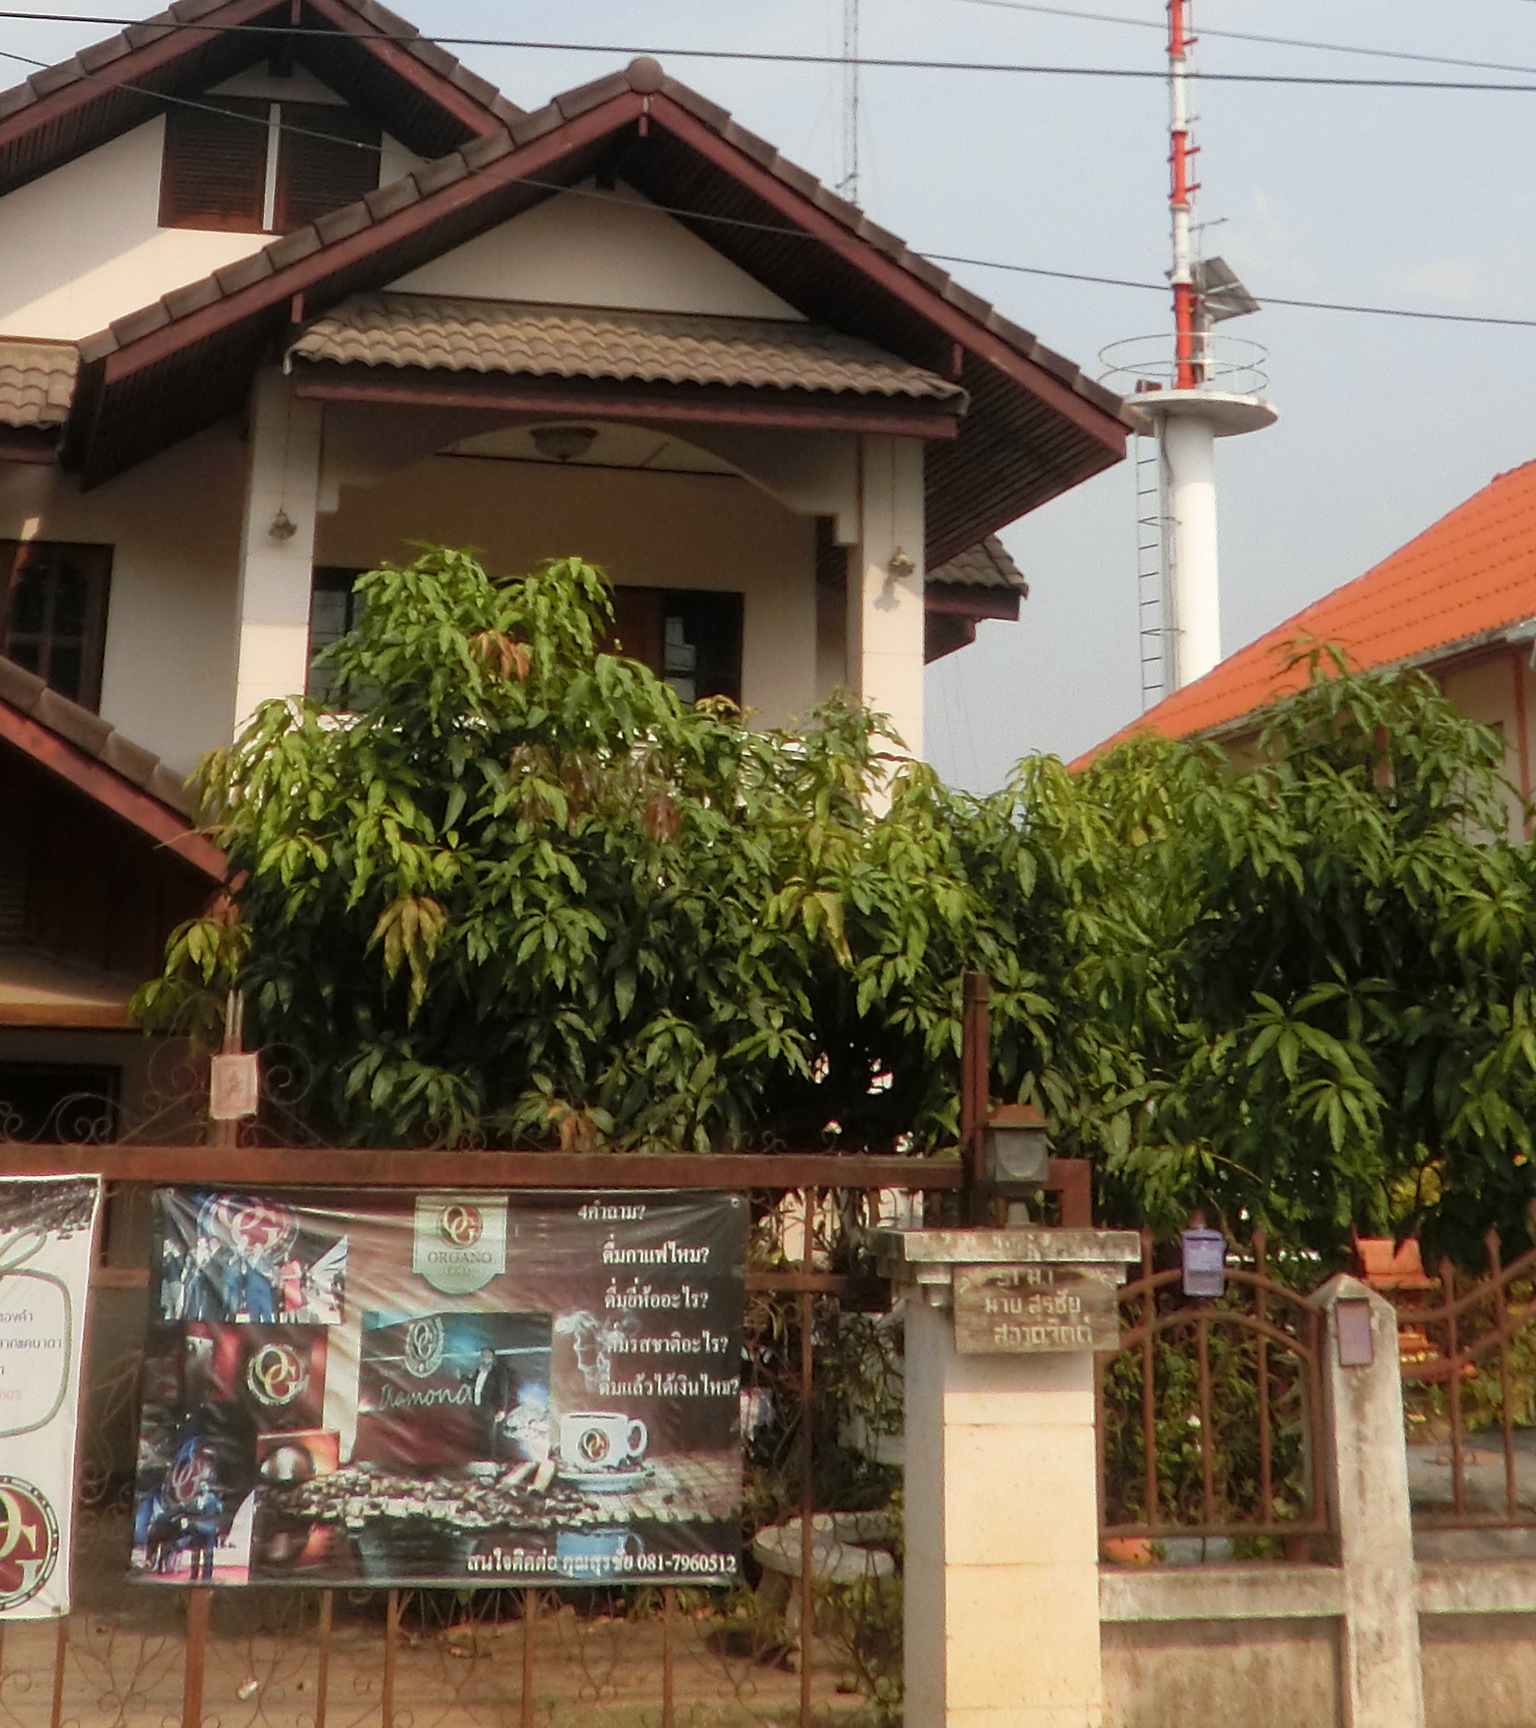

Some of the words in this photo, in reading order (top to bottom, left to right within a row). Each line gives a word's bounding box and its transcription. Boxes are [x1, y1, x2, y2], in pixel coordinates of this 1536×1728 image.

[577, 1199, 647, 1221] 4คำถาม?
[427, 1250, 493, 1265] ORGANO
[601, 1233, 710, 1265] ดื่มกาแฟไหม?
[604, 1276, 710, 1309] ดื่มยี่ห้ออะไร?
[604, 1321, 729, 1354] ดื่มรสชาติอะไร?
[467, 1546, 557, 1572] สนใจติดต่อ
[562, 1547, 633, 1578] คุณสุรชัย
[637, 1552, 737, 1573] 081-7960512
